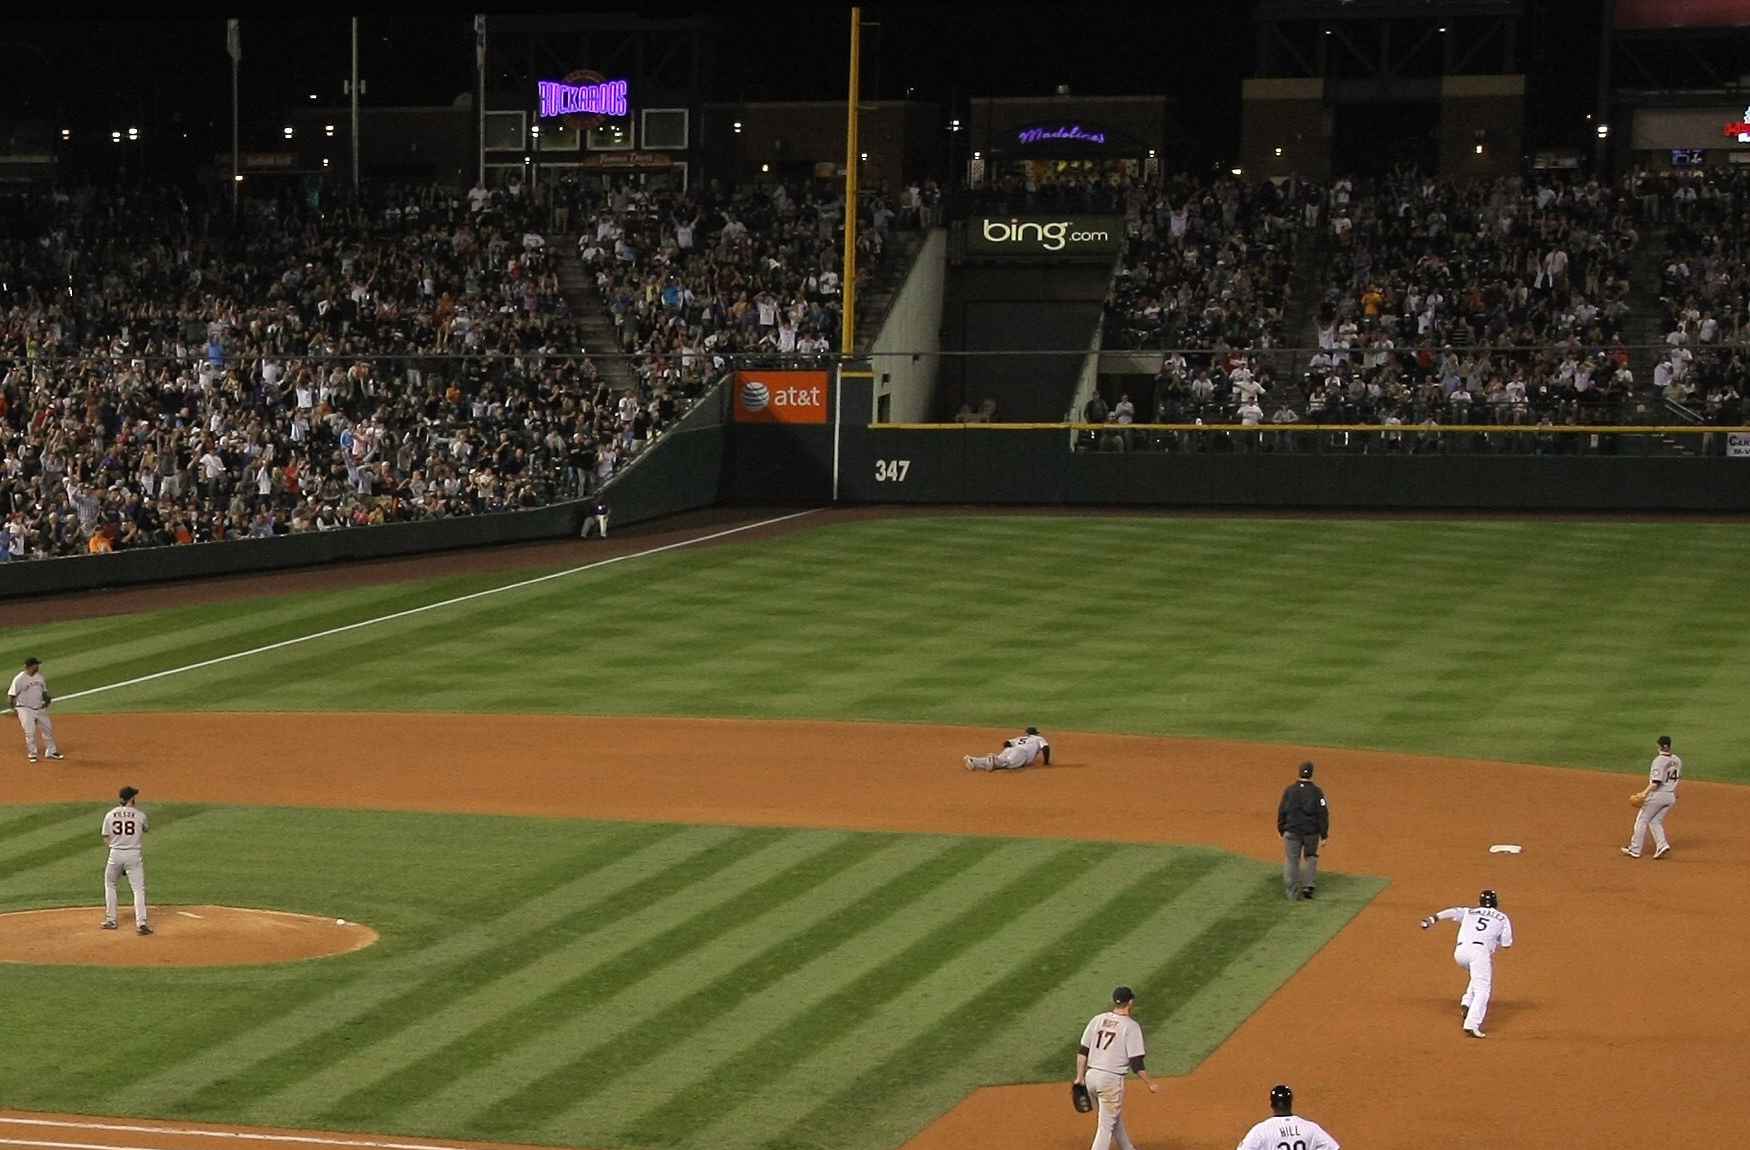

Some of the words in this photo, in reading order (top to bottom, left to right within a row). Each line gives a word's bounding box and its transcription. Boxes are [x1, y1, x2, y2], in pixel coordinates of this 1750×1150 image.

[538, 80, 627, 117] BUCKAROOS
[774, 386, 820, 406] at&t
[874, 460, 910, 482] 347
[1665, 769, 1679, 783] 14
[112, 821, 135, 835] 38
[1475, 917, 1490, 932] 5
[1096, 1030, 1116, 1050] 17
[1280, 1125, 1300, 1137] HILL
